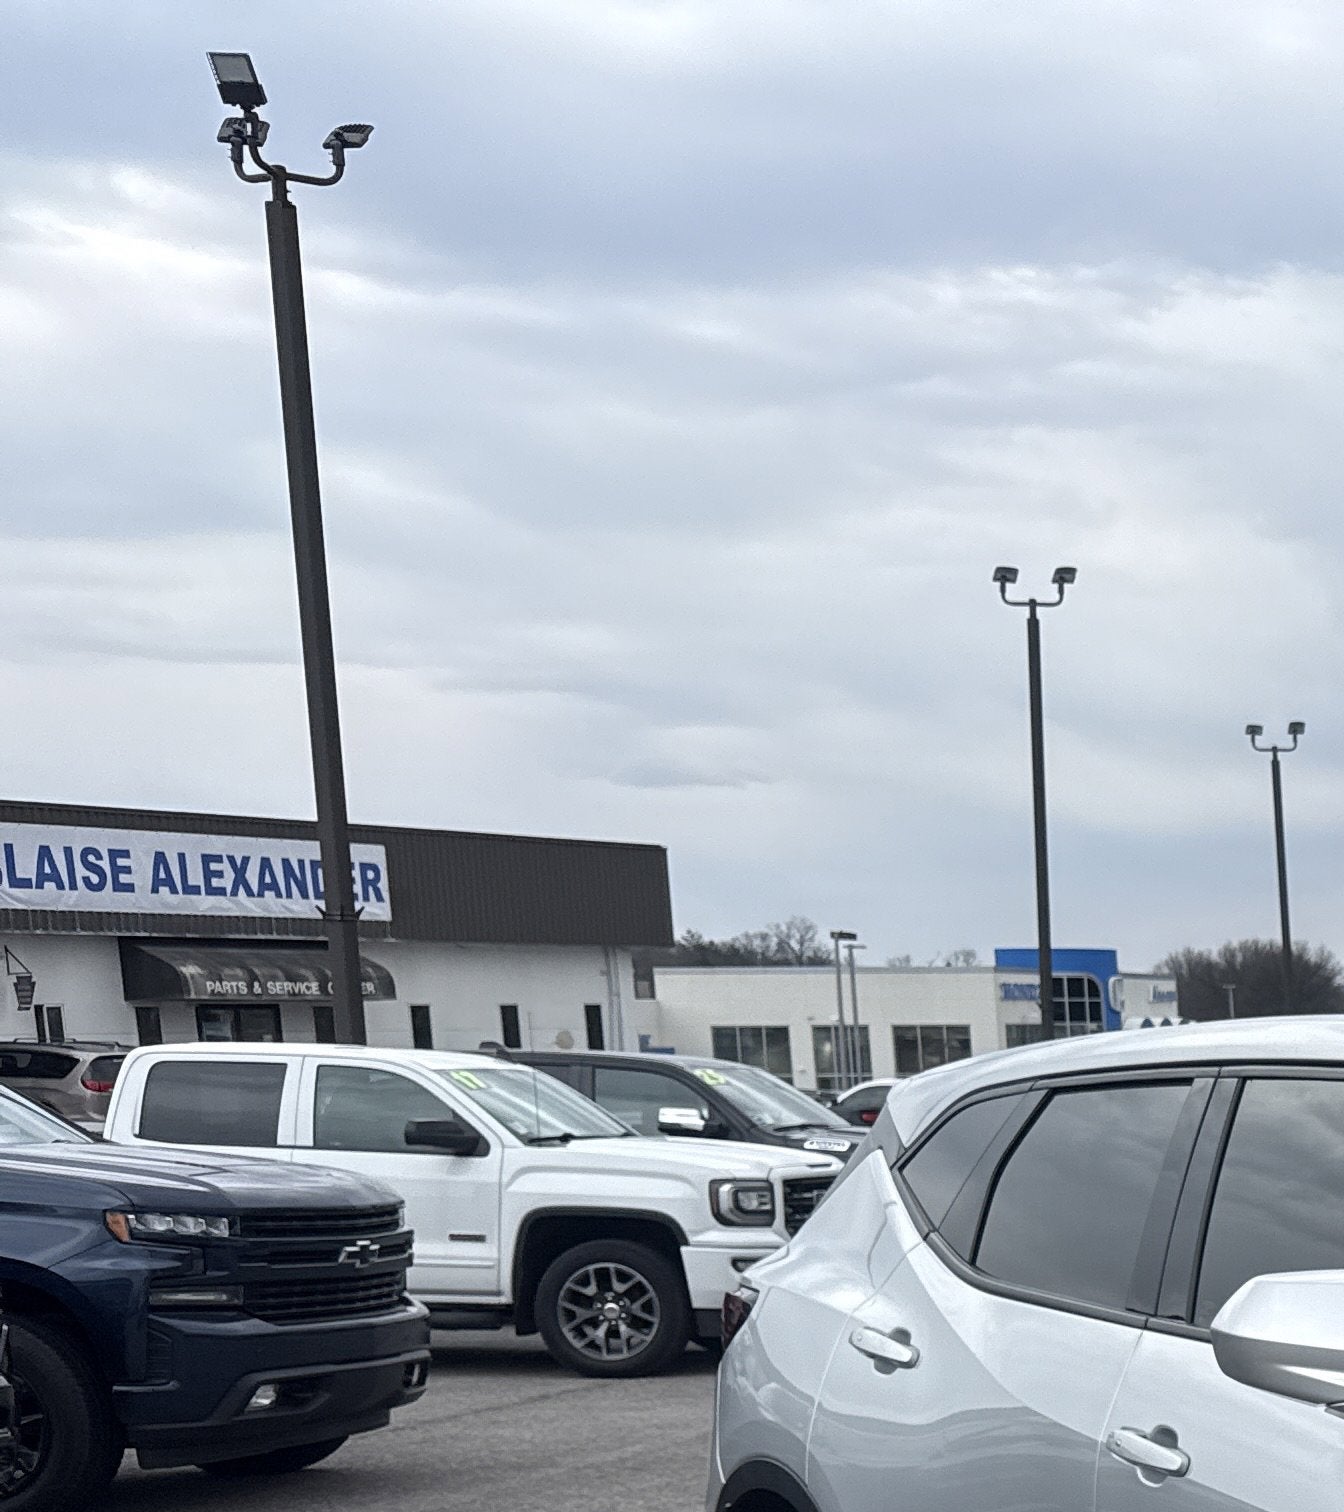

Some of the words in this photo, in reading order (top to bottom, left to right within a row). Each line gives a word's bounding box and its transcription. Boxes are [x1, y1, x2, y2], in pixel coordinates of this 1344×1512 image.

[0, 842, 136, 894] LAISE
[206, 980, 248, 995] PARTS
[253, 980, 263, 995] &
[267, 981, 321, 996] SERVICE
